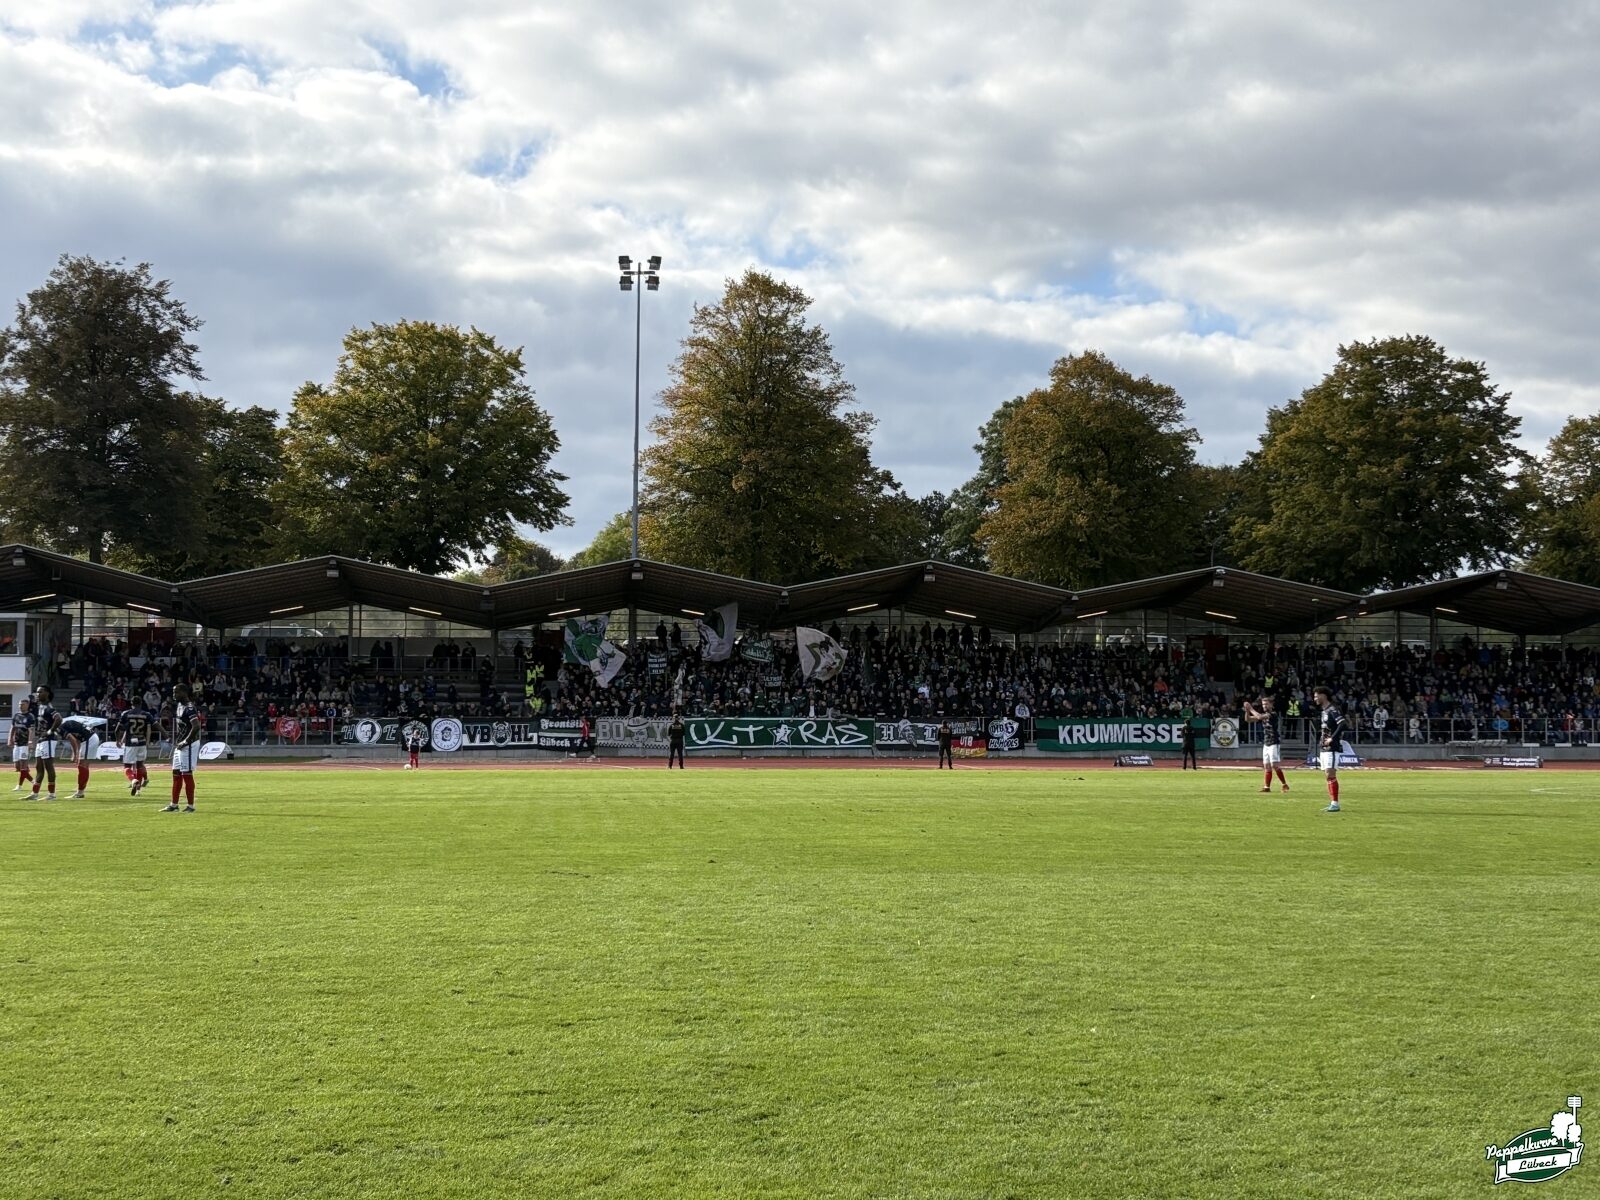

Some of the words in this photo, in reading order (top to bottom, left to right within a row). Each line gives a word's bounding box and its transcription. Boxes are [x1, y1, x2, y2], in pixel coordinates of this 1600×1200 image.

[129, 719, 145, 735] 22
[1058, 723, 1184, 745] KRUMMESSE
[539, 736, 570, 747] Lübeck
